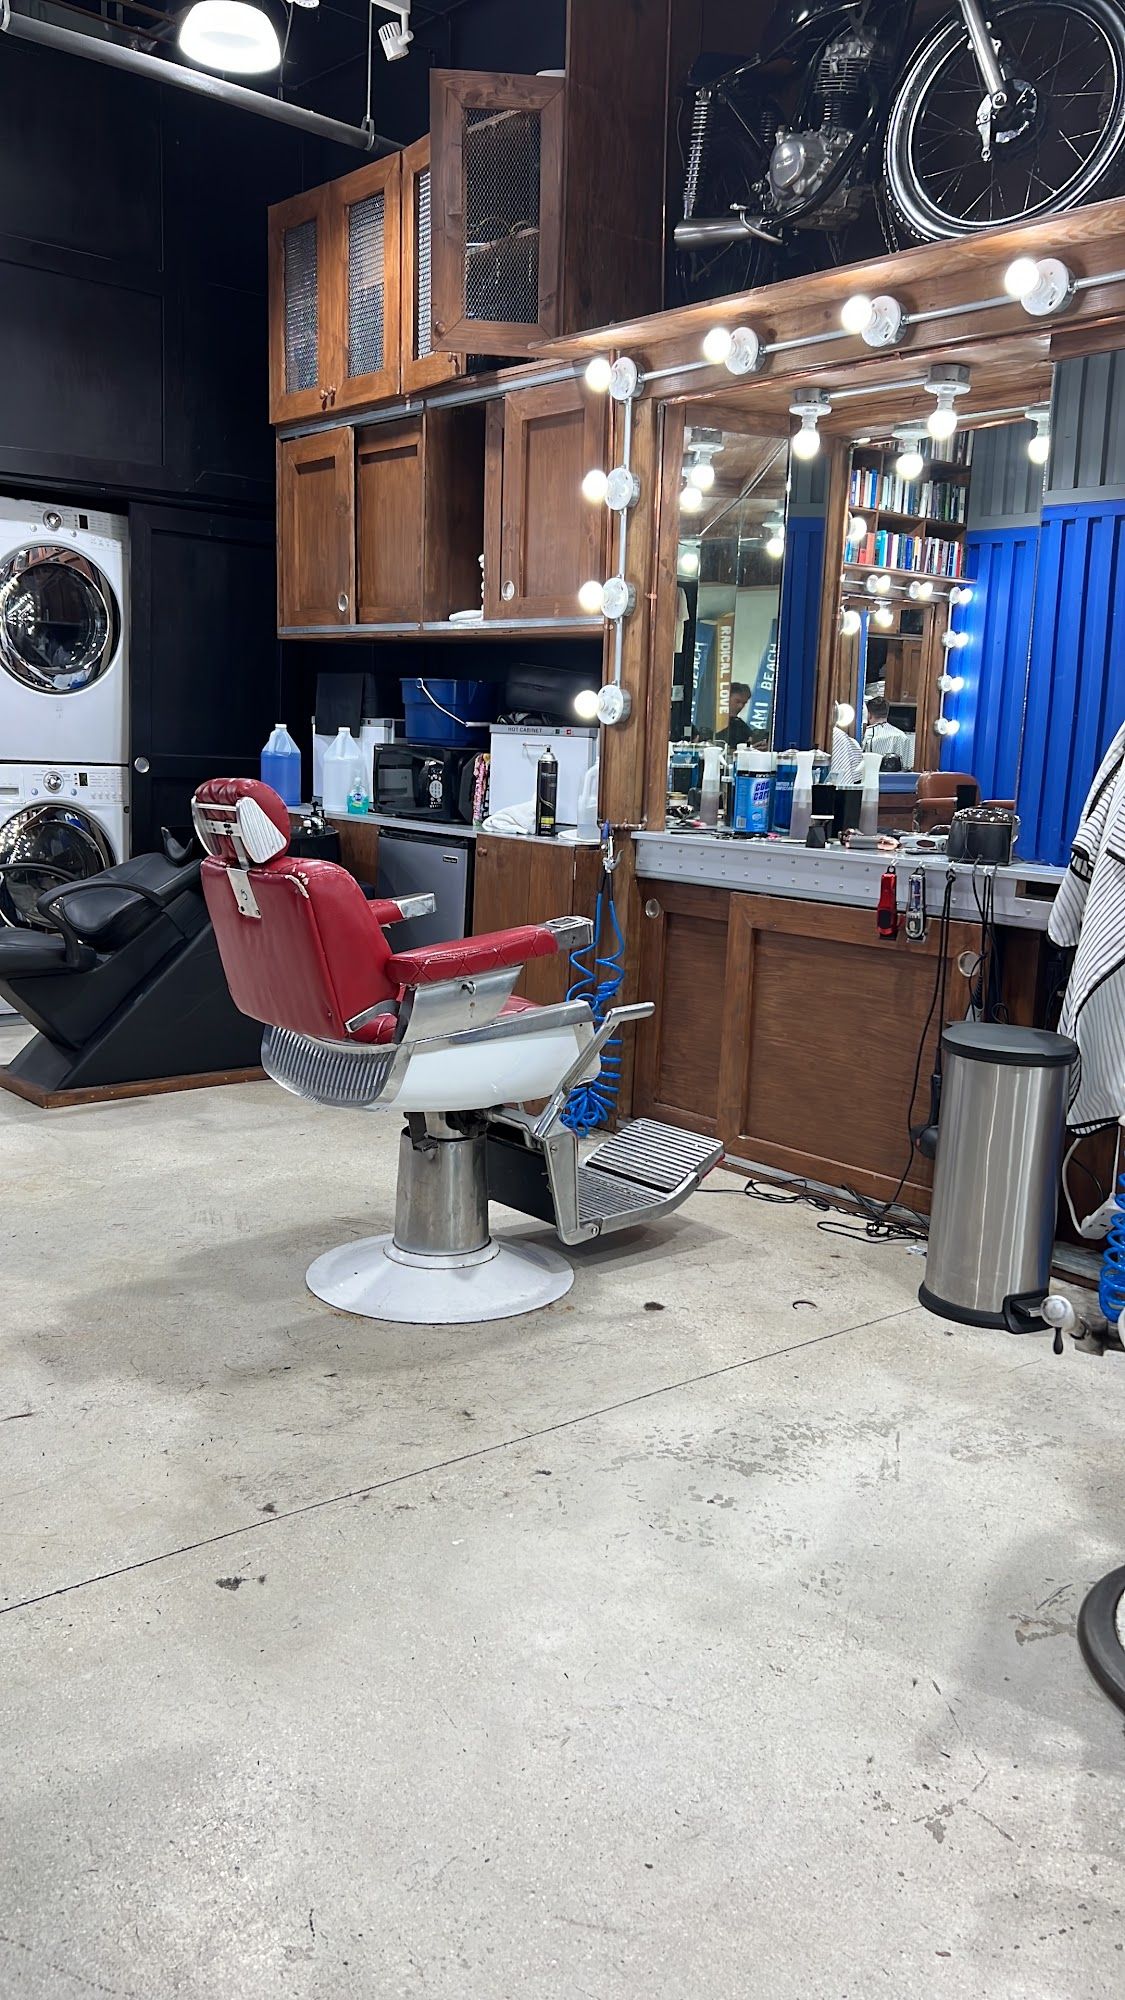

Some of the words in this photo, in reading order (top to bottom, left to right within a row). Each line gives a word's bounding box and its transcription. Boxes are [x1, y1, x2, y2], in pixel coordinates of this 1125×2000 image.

[720, 626, 731, 679] RADICAL
[760, 643, 777, 691] BEACH
[720, 682, 730, 714] LOVE
